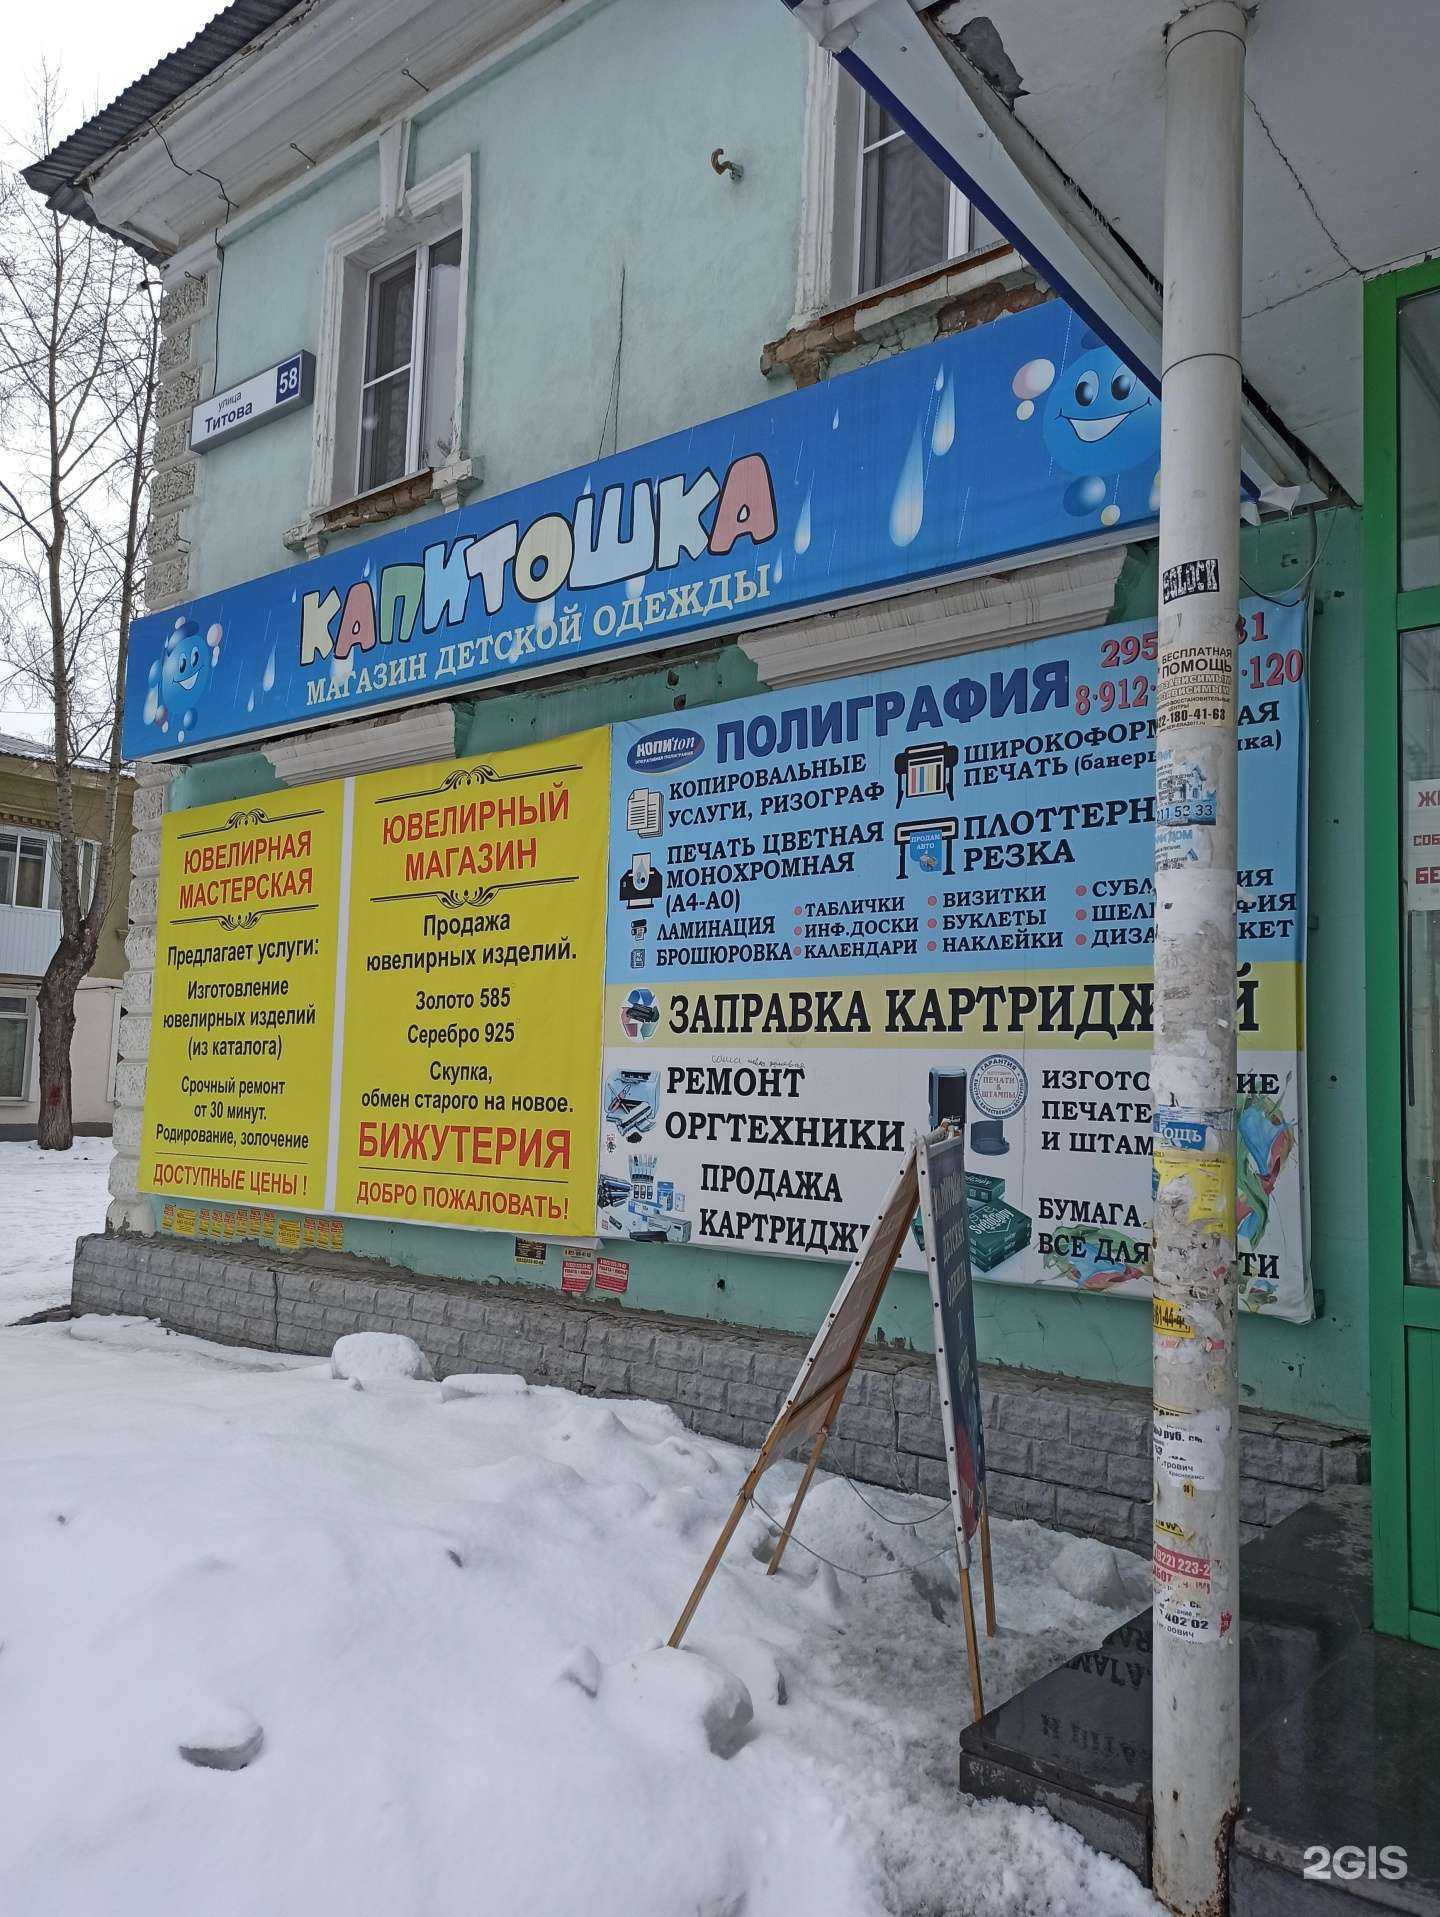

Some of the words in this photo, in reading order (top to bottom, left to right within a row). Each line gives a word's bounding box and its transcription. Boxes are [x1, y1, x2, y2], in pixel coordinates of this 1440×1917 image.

[279, 366, 298, 394] 58
[204, 402, 253, 433] Титова
[218, 391, 242, 413] улица
[301, 453, 778, 665] КАПИТОШКА
[306, 653, 427, 706] МАГАЗИН
[434, 604, 582, 678] ДЕТСКОЙ
[593, 564, 771, 640] ОДЕЖДЫ
[1161, 646, 1232, 665] БЕСПЛАТНАЯ
[1162, 658, 1232, 679] ПОМОЩЬ
[716, 659, 1070, 764] ПОЛИГРАФИЯ
[668, 753, 867, 801] КОПИРОВАЛЬНЫЕ
[963, 755, 1069, 788] ПЕЧАТЬ
[383, 781, 570, 846] ЮВЕЛИРНЫЙ
[667, 799, 753, 828] УСЛУГИ,
[760, 781, 886, 817] РИЗОГРАФ
[964, 795, 1156, 841] ПЛОТТЕРН
[183, 830, 313, 875] ЮВЕЛИРНАЯ
[667, 838, 756, 867] ПЕЧАТЬ
[762, 820, 885, 857] ЦВЕТНАЯ
[963, 837, 1075, 872] РЕЗКА
[404, 837, 538, 883] МАГАЗИН
[666, 851, 855, 890] МОНОХРОМНАЯ
[178, 867, 314, 910] МАСТЕРСКАЯ
[943, 885, 1047, 910] ВИЗИТКИ
[804, 896, 905, 918] ТАБЛИЧКИ
[942, 908, 1047, 932] БУКЛЕТЫ
[423, 911, 512, 939] Продажа
[657, 915, 776, 941] ЛАМИНАЦИЯ
[804, 917, 919, 940] ИНФ.ДОСКИ
[167, 946, 254, 972] Предлагает
[257, 938, 320, 965] услуги:
[366, 948, 477, 976] ювелирных
[482, 937, 578, 968] изделий.
[656, 942, 793, 968] БРОШЮРОВКА
[804, 938, 918, 960] КАЛЕНДАРИ
[942, 930, 1064, 953] НАКЛЕЙКИ
[187, 979, 290, 1000] Изготовление
[415, 990, 475, 1012] Золото
[479, 986, 512, 1009] 585
[163, 1010, 246, 1034] ювелирных
[250, 1003, 317, 1029] изделий
[668, 990, 872, 1035] ЗАПРАВКА
[188, 1038, 209, 1061] (из
[212, 1034, 283, 1061] каталога)
[407, 1023, 480, 1050] Серебро
[484, 1021, 516, 1044] 925
[181, 1076, 236, 1098] Срочный
[238, 1079, 286, 1099] ремонт
[429, 1060, 494, 1086] Скупка,
[666, 1066, 806, 1098] РЕМОНТ
[194, 1104, 207, 1119] от
[209, 1101, 224, 1120] 30
[226, 1103, 268, 1122] минут.
[361, 1087, 411, 1110] обмен
[414, 1091, 479, 1115] старого
[483, 1094, 507, 1111] на
[511, 1094, 575, 1114] новое.
[1041, 1100, 1152, 1124] ПЕЧАТЕ
[155, 1123, 237, 1149] Родирование,
[240, 1131, 310, 1150] золочение
[358, 1120, 572, 1171] БИЖУТЕРИЯ
[665, 1111, 905, 1152] ОРГТЕХНИКИ
[1041, 1131, 1060, 1151] И
[152, 1163, 246, 1192] ДОСТУПНЫЕ
[250, 1168, 299, 1196] ЦЕНЫ
[700, 1163, 843, 1203] ПРОДАЖА
[356, 1180, 418, 1207] ДОБРО
[423, 1186, 570, 1221] ПОЖАЛОВАТЬ!
[1038, 1232, 1086, 1258] ВСЕ
[1094, 1237, 1150, 1265] ДЛЯ
